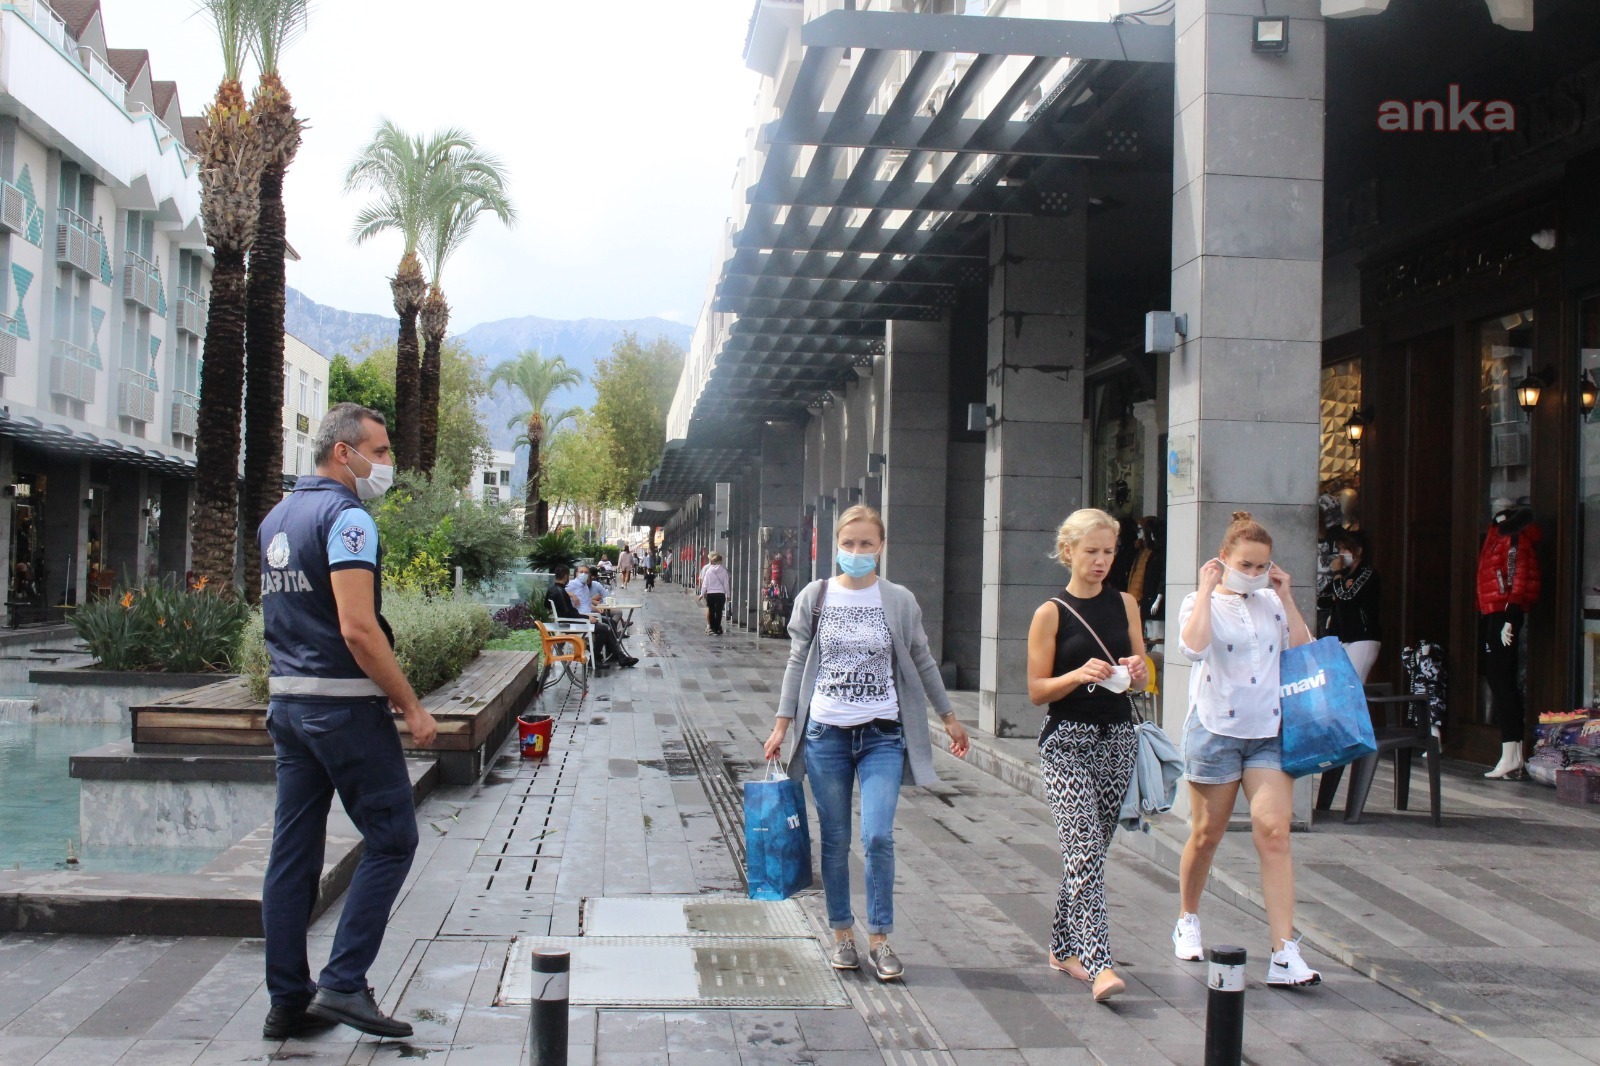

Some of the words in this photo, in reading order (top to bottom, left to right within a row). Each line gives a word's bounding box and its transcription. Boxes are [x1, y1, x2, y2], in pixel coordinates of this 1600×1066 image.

[261, 570, 313, 595] ZABITA
[830, 672, 876, 684] WILD
[1280, 669, 1326, 697] mavi
[817, 684, 887, 697] NATURE
